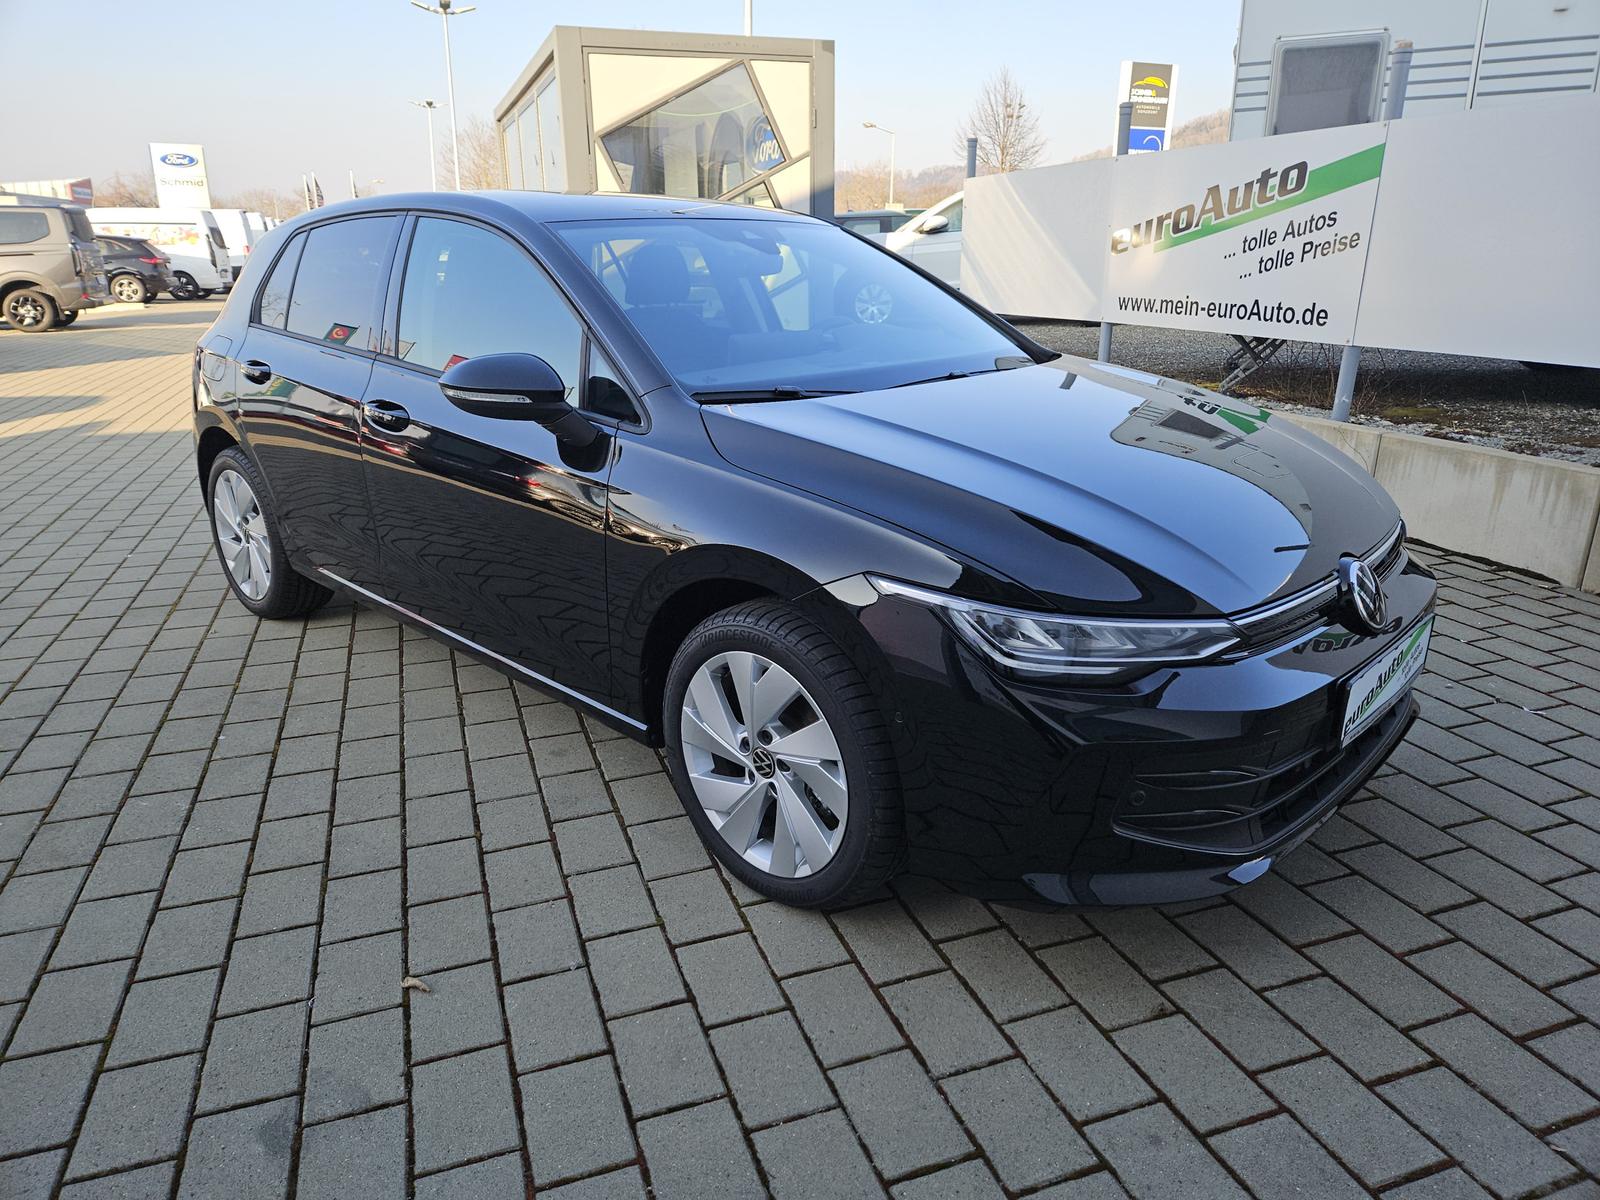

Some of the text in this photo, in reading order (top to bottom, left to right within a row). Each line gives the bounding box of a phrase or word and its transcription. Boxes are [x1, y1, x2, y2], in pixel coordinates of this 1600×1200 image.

[160, 177, 204, 187] Schmid
[1111, 160, 1308, 256] euroAuto
[1242, 228, 1277, 254] tolle
[1282, 211, 1338, 242] Autos
[1258, 248, 1294, 274] tolle
[1300, 231, 1361, 263] Preise
[1118, 295, 1329, 327] www.mein-euroAuto.de
[699, 628, 778, 651] BRIDGESTONE
[1344, 649, 1404, 734] euroAuto
